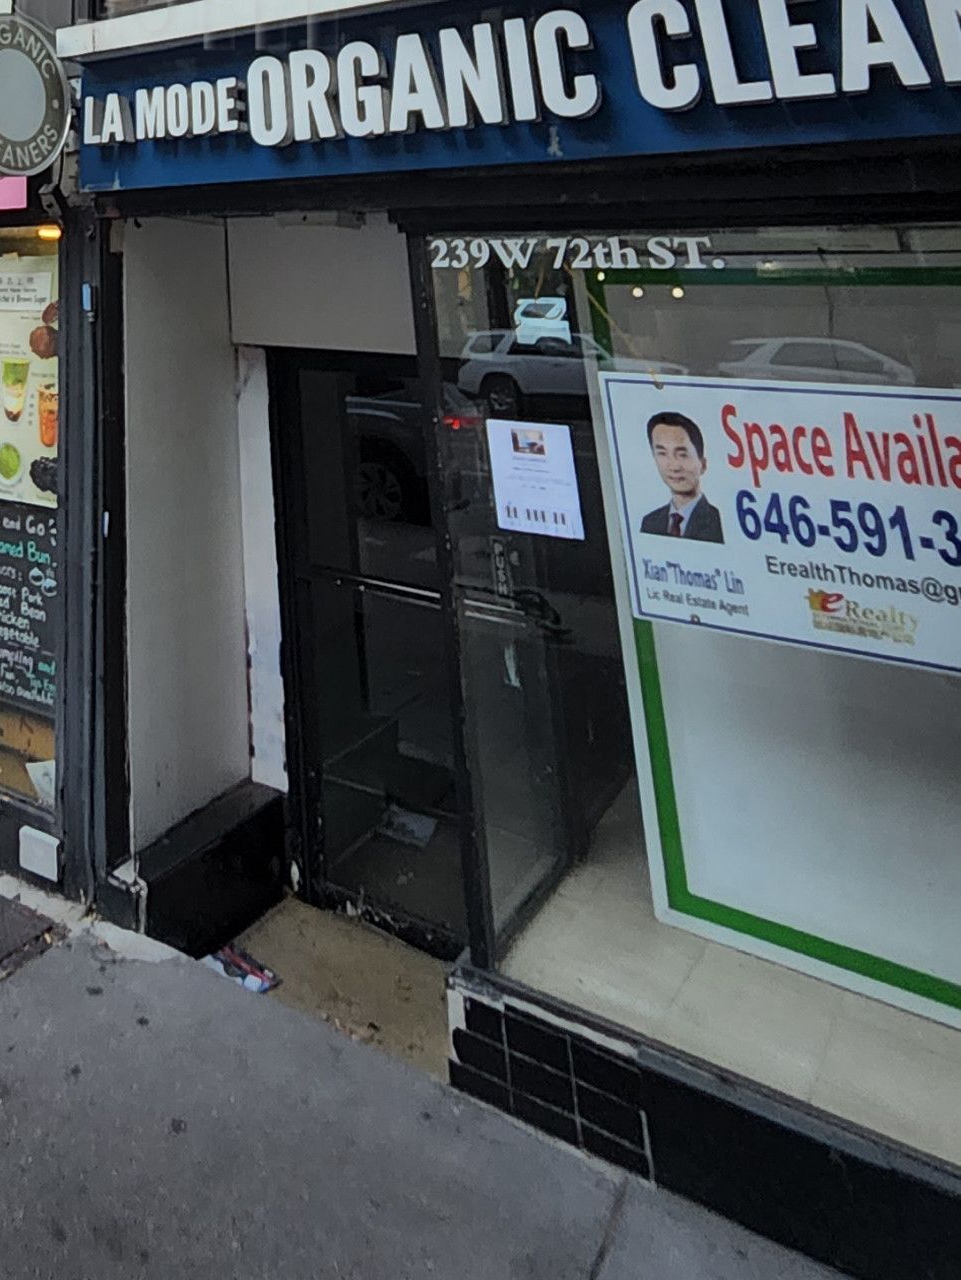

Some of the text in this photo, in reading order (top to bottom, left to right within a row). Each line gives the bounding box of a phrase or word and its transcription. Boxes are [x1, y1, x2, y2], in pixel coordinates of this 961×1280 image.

[84, 93, 124, 144] LA
[136, 77, 238, 140] MODE
[247, 10, 600, 146] ORGANIC
[546, 236, 641, 269] 72th
[647, 236, 725, 269] ST.
[720, 404, 835, 488] Space
[736, 489, 961, 568] 646-591-3
[724, 567, 744, 595] Lin
[765, 555, 961, 606] ErealthThomas@g
[20, 601, 47, 622] Bean
[662, 589, 683, 605] Real
[685, 593, 716, 611] Estate
[718, 599, 750, 617] Agent
